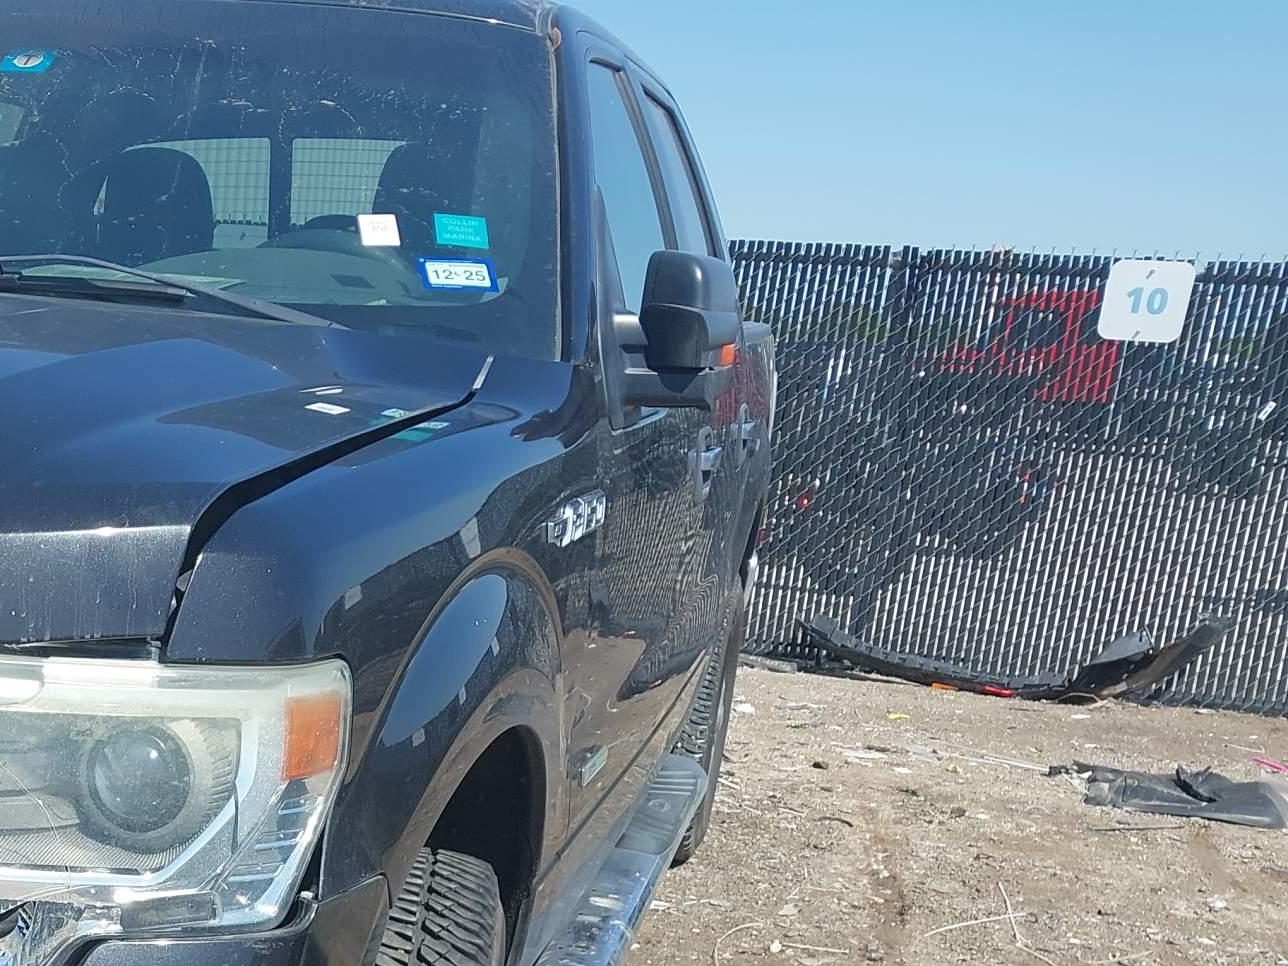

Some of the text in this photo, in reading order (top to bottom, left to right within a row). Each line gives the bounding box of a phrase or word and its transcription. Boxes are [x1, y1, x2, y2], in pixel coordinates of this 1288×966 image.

[442, 217, 479, 226] COLLIN
[443, 233, 481, 241] MARINA
[1126, 287, 1169, 315] 10
